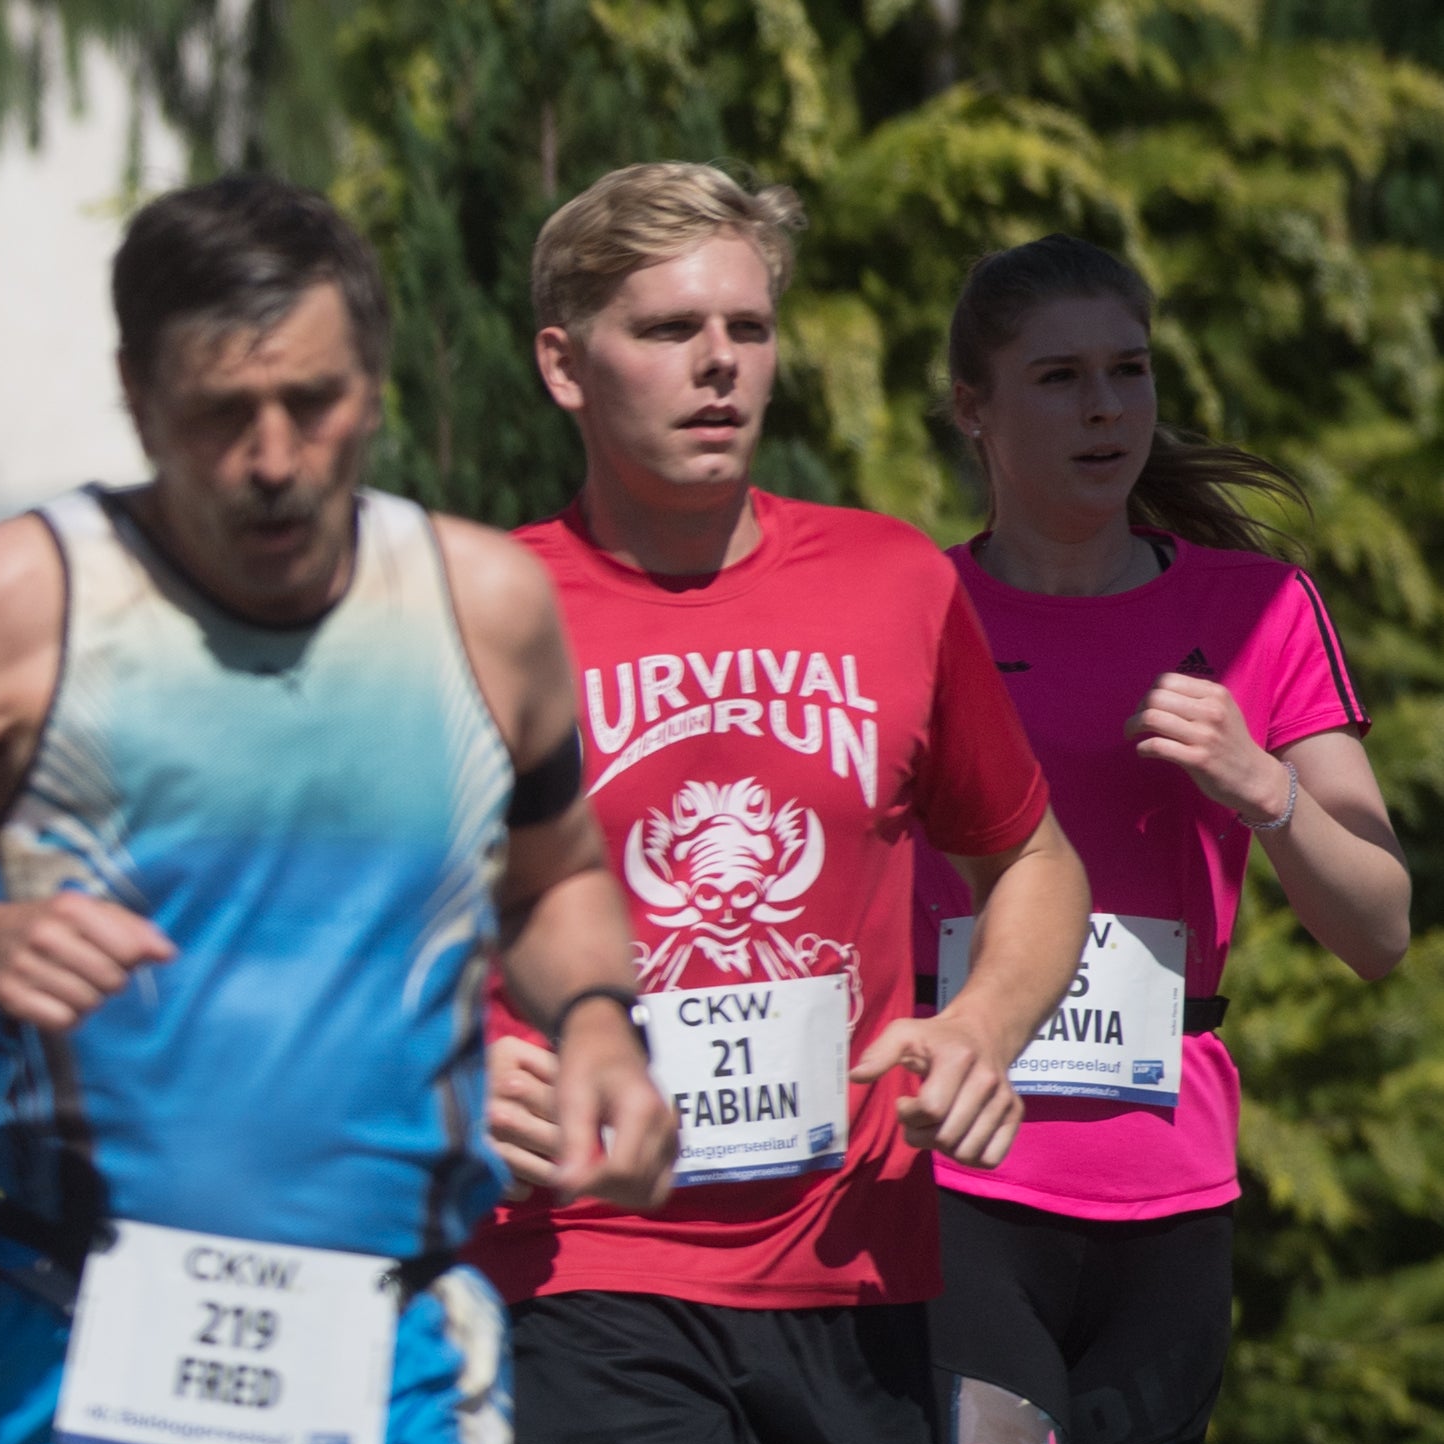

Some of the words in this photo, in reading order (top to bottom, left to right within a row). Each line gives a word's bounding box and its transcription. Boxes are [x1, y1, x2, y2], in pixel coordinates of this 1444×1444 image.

[584, 648, 878, 755] URVIVAL
[713, 698, 878, 809] RUN
[1067, 962, 1089, 998] 5
[1034, 1008, 1123, 1046] AVIA
[711, 1037, 752, 1077] 21
[672, 1081, 800, 1130] FABIAN
[195, 1300, 279, 1352] 219
[172, 1357, 283, 1409] FRED
